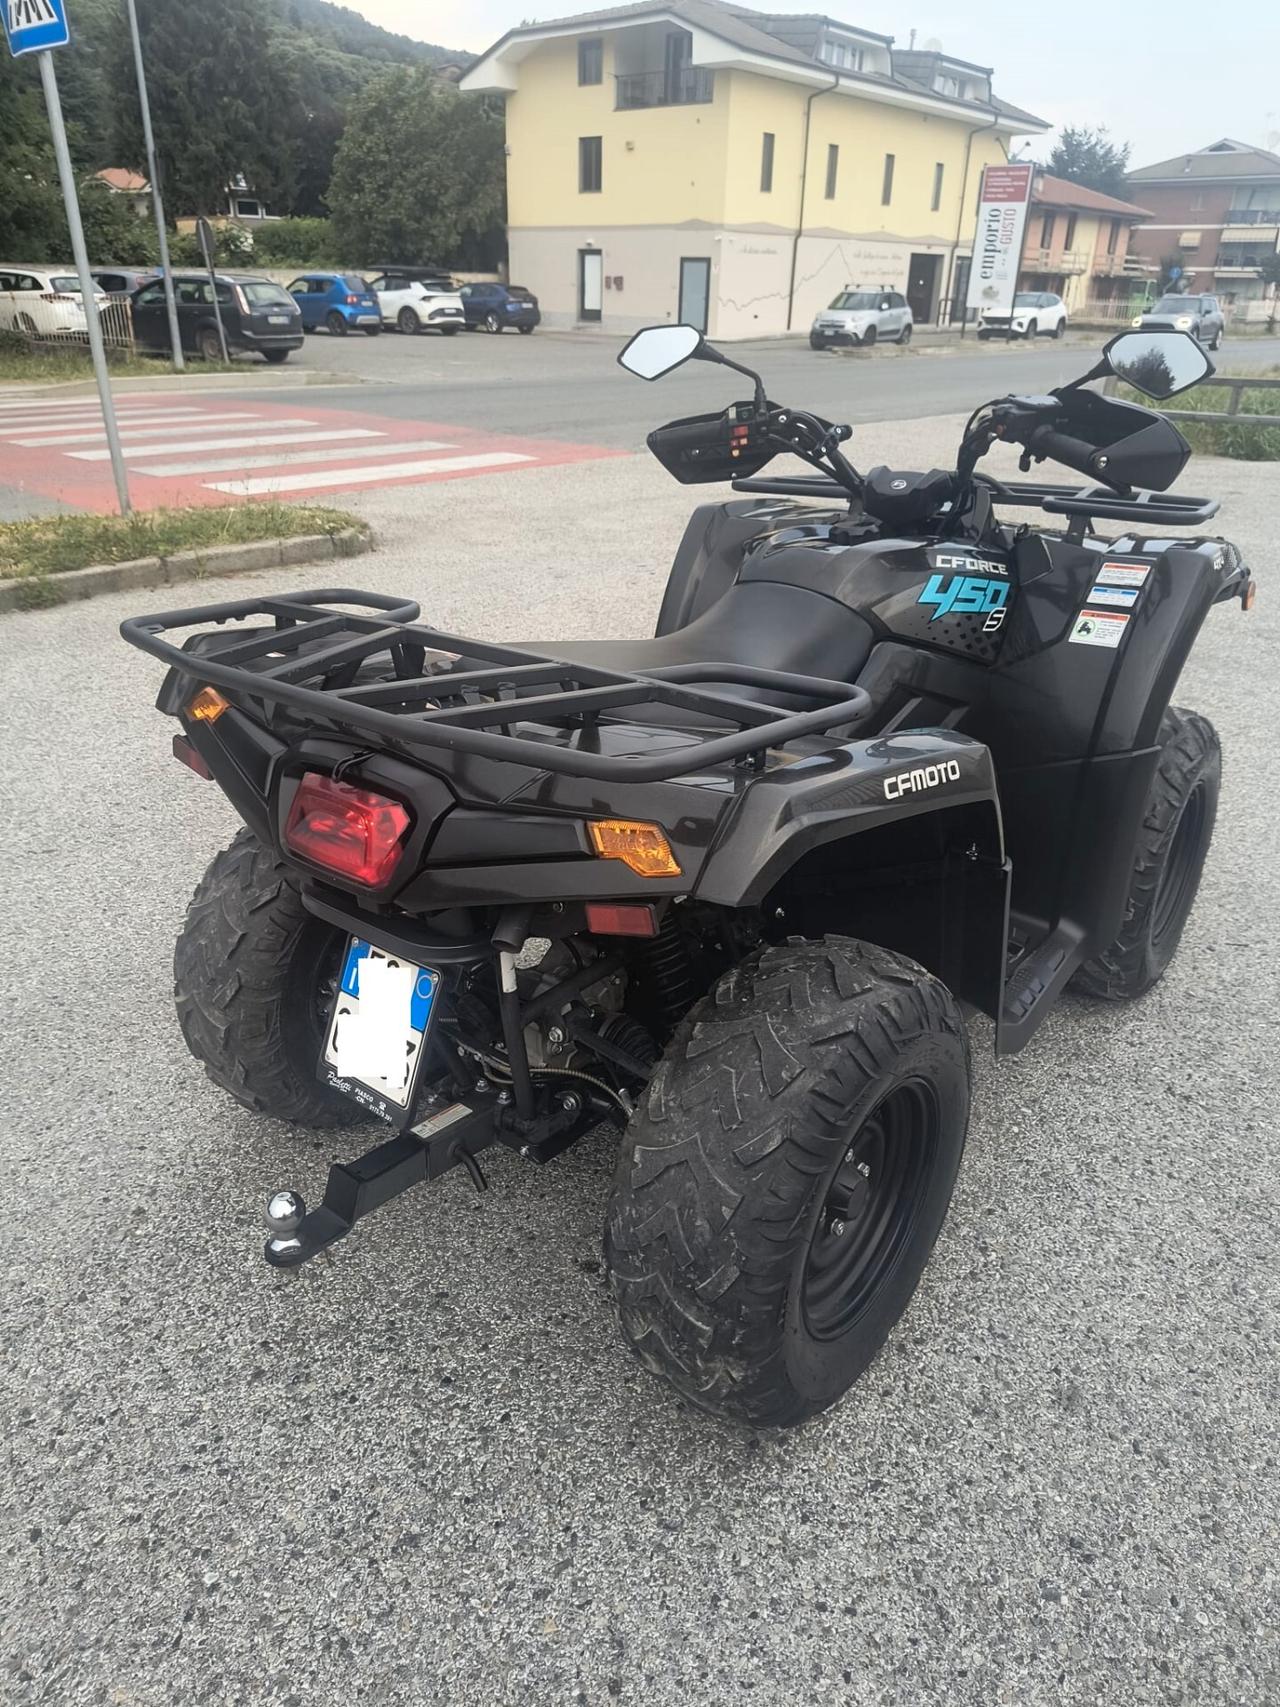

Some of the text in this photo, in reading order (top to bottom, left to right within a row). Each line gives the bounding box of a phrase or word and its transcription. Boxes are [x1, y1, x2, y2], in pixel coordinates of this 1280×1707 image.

[980, 208, 1002, 280] emporio
[1000, 208, 1017, 245] GUSTO
[935, 554, 1008, 575] CFORCE
[917, 574, 1011, 621] 450
[982, 607, 1007, 631] S
[883, 759, 960, 800] CFMOTO
